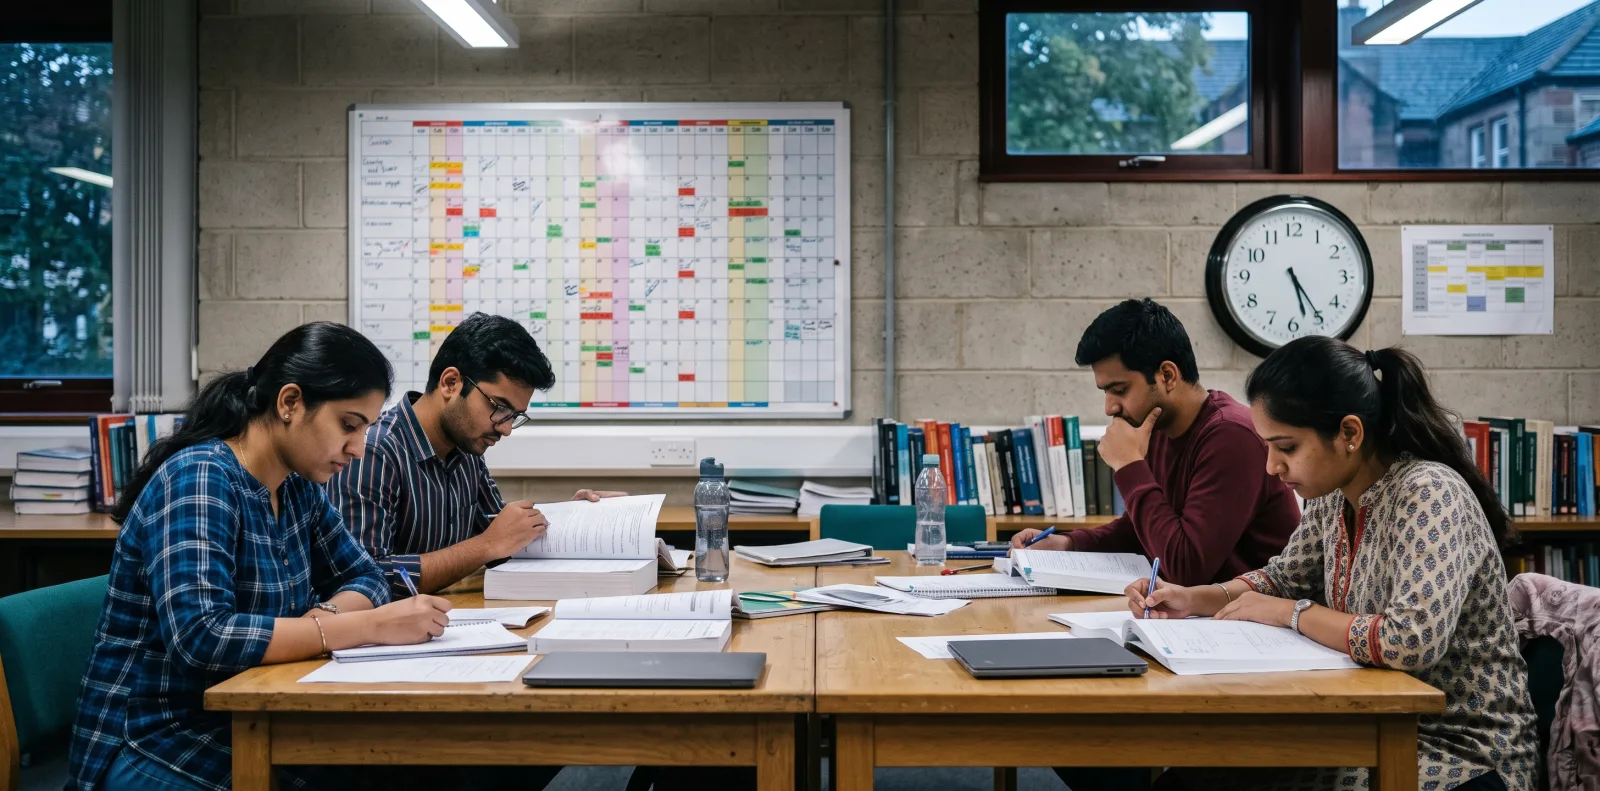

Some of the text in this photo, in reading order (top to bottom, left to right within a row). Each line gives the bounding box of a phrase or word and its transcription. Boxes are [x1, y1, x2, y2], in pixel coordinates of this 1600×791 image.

[1265, 230, 1278, 244] 11
[1286, 222, 1302, 237] 12
[1315, 229, 1320, 244] 1
[1248, 248, 1265, 263] 10
[1329, 245, 1340, 259] 2
[1239, 269, 1250, 284] 9
[1339, 270, 1348, 285] 3
[1246, 293, 1258, 308] 8
[1328, 294, 1340, 309] 4
[1266, 311, 1277, 325] 7
[1287, 317, 1299, 332] 6
[1313, 310, 1324, 325] 5
